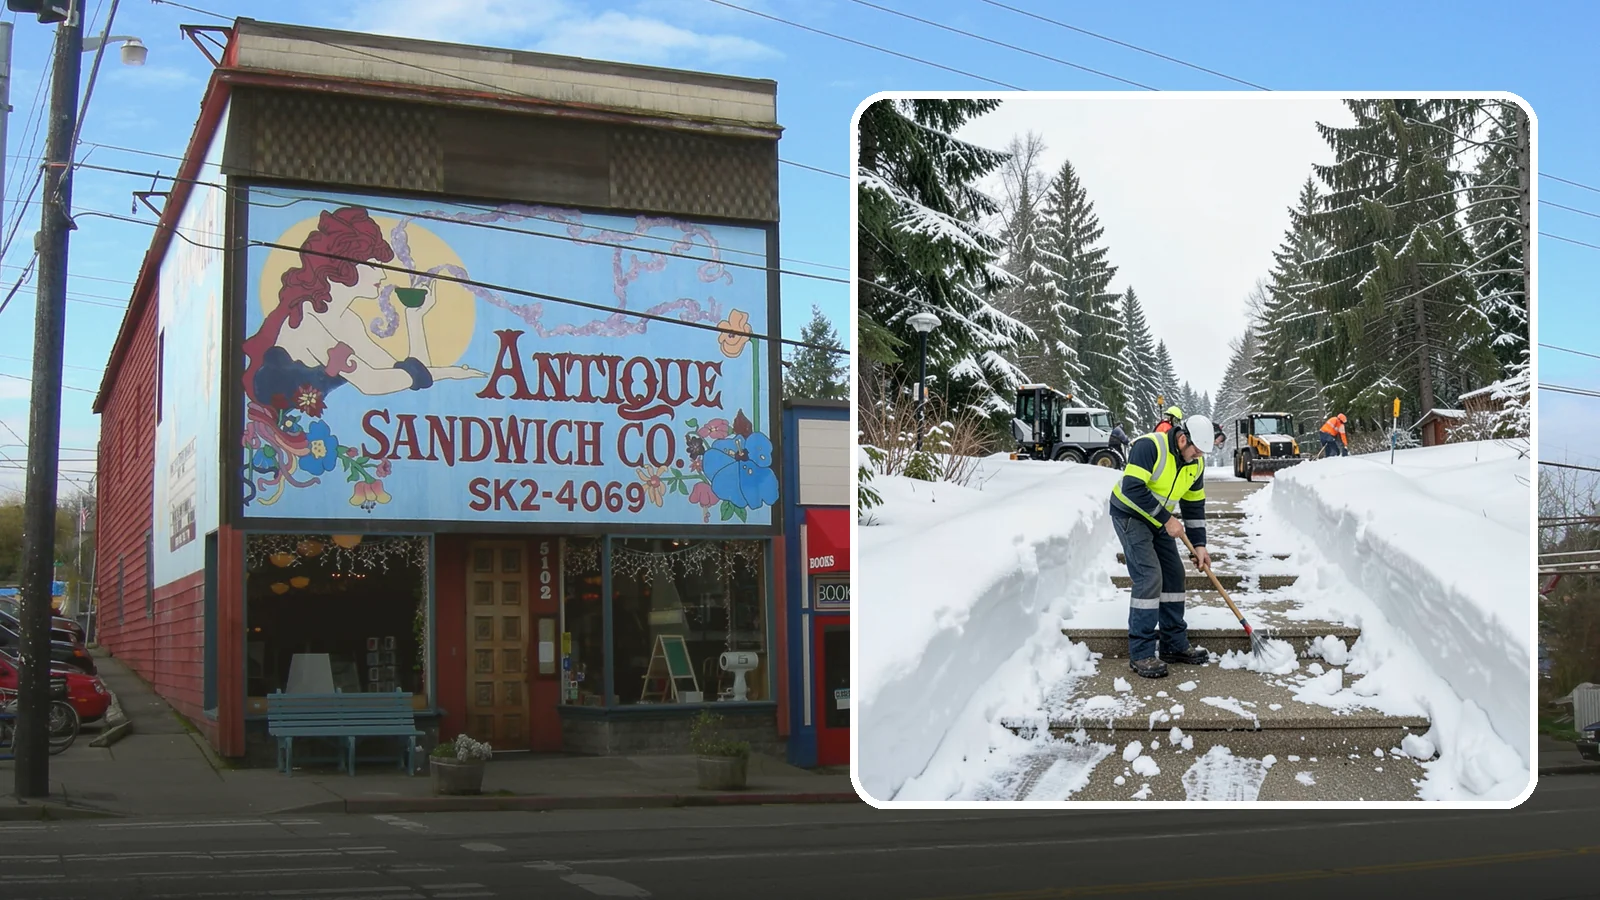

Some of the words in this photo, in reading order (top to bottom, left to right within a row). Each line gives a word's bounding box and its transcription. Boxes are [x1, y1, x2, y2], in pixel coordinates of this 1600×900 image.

[476, 329, 723, 421] ANTIQUE
[361, 408, 604, 467] SANDWICH
[617, 422, 684, 469] CO.
[468, 477, 646, 513] SK2-4069
[540, 541, 552, 600] 5102
[809, 555, 835, 569] BOOKS
